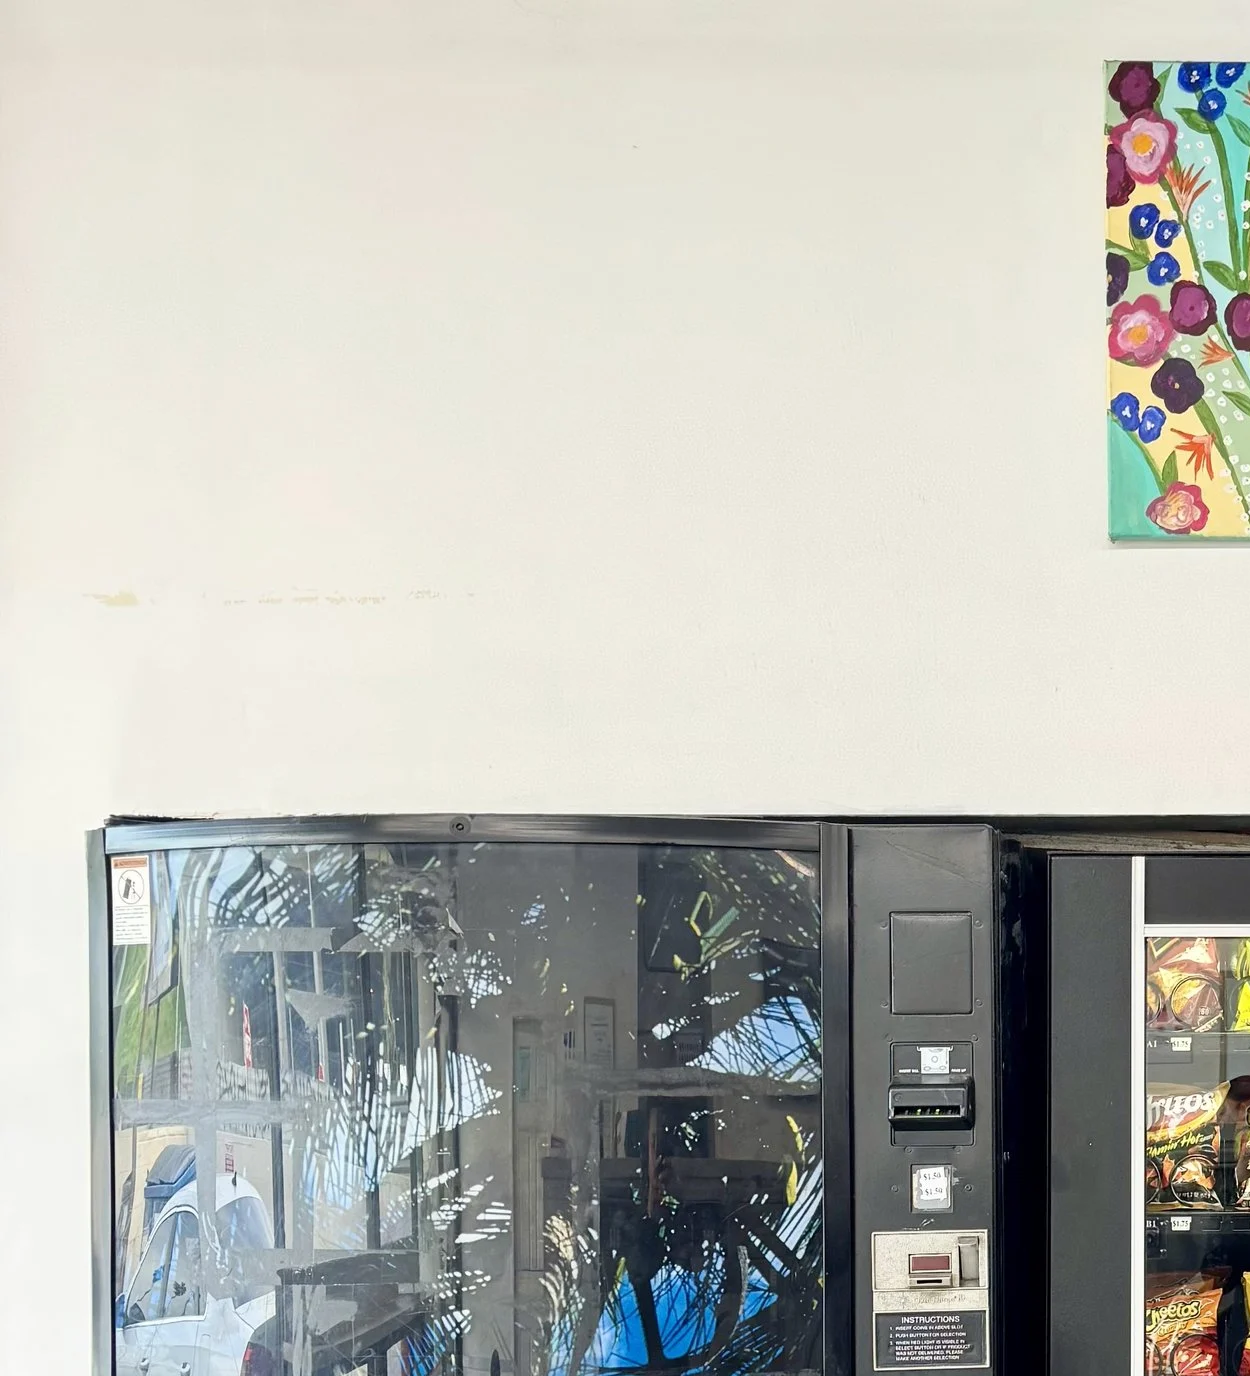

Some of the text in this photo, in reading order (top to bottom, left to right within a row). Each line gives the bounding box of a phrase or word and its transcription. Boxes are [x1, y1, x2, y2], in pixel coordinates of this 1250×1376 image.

[1146, 1040, 1157, 1048] A1
[1180, 1130, 1205, 1150] Hot
[923, 1172, 942, 1181] $1.50
[924, 1187, 943, 1196] $1.50
[1146, 1220, 1157, 1228] B1
[1172, 1220, 1189, 1228] $1.75
[901, 1315, 961, 1324] INSTRUCTIONS
